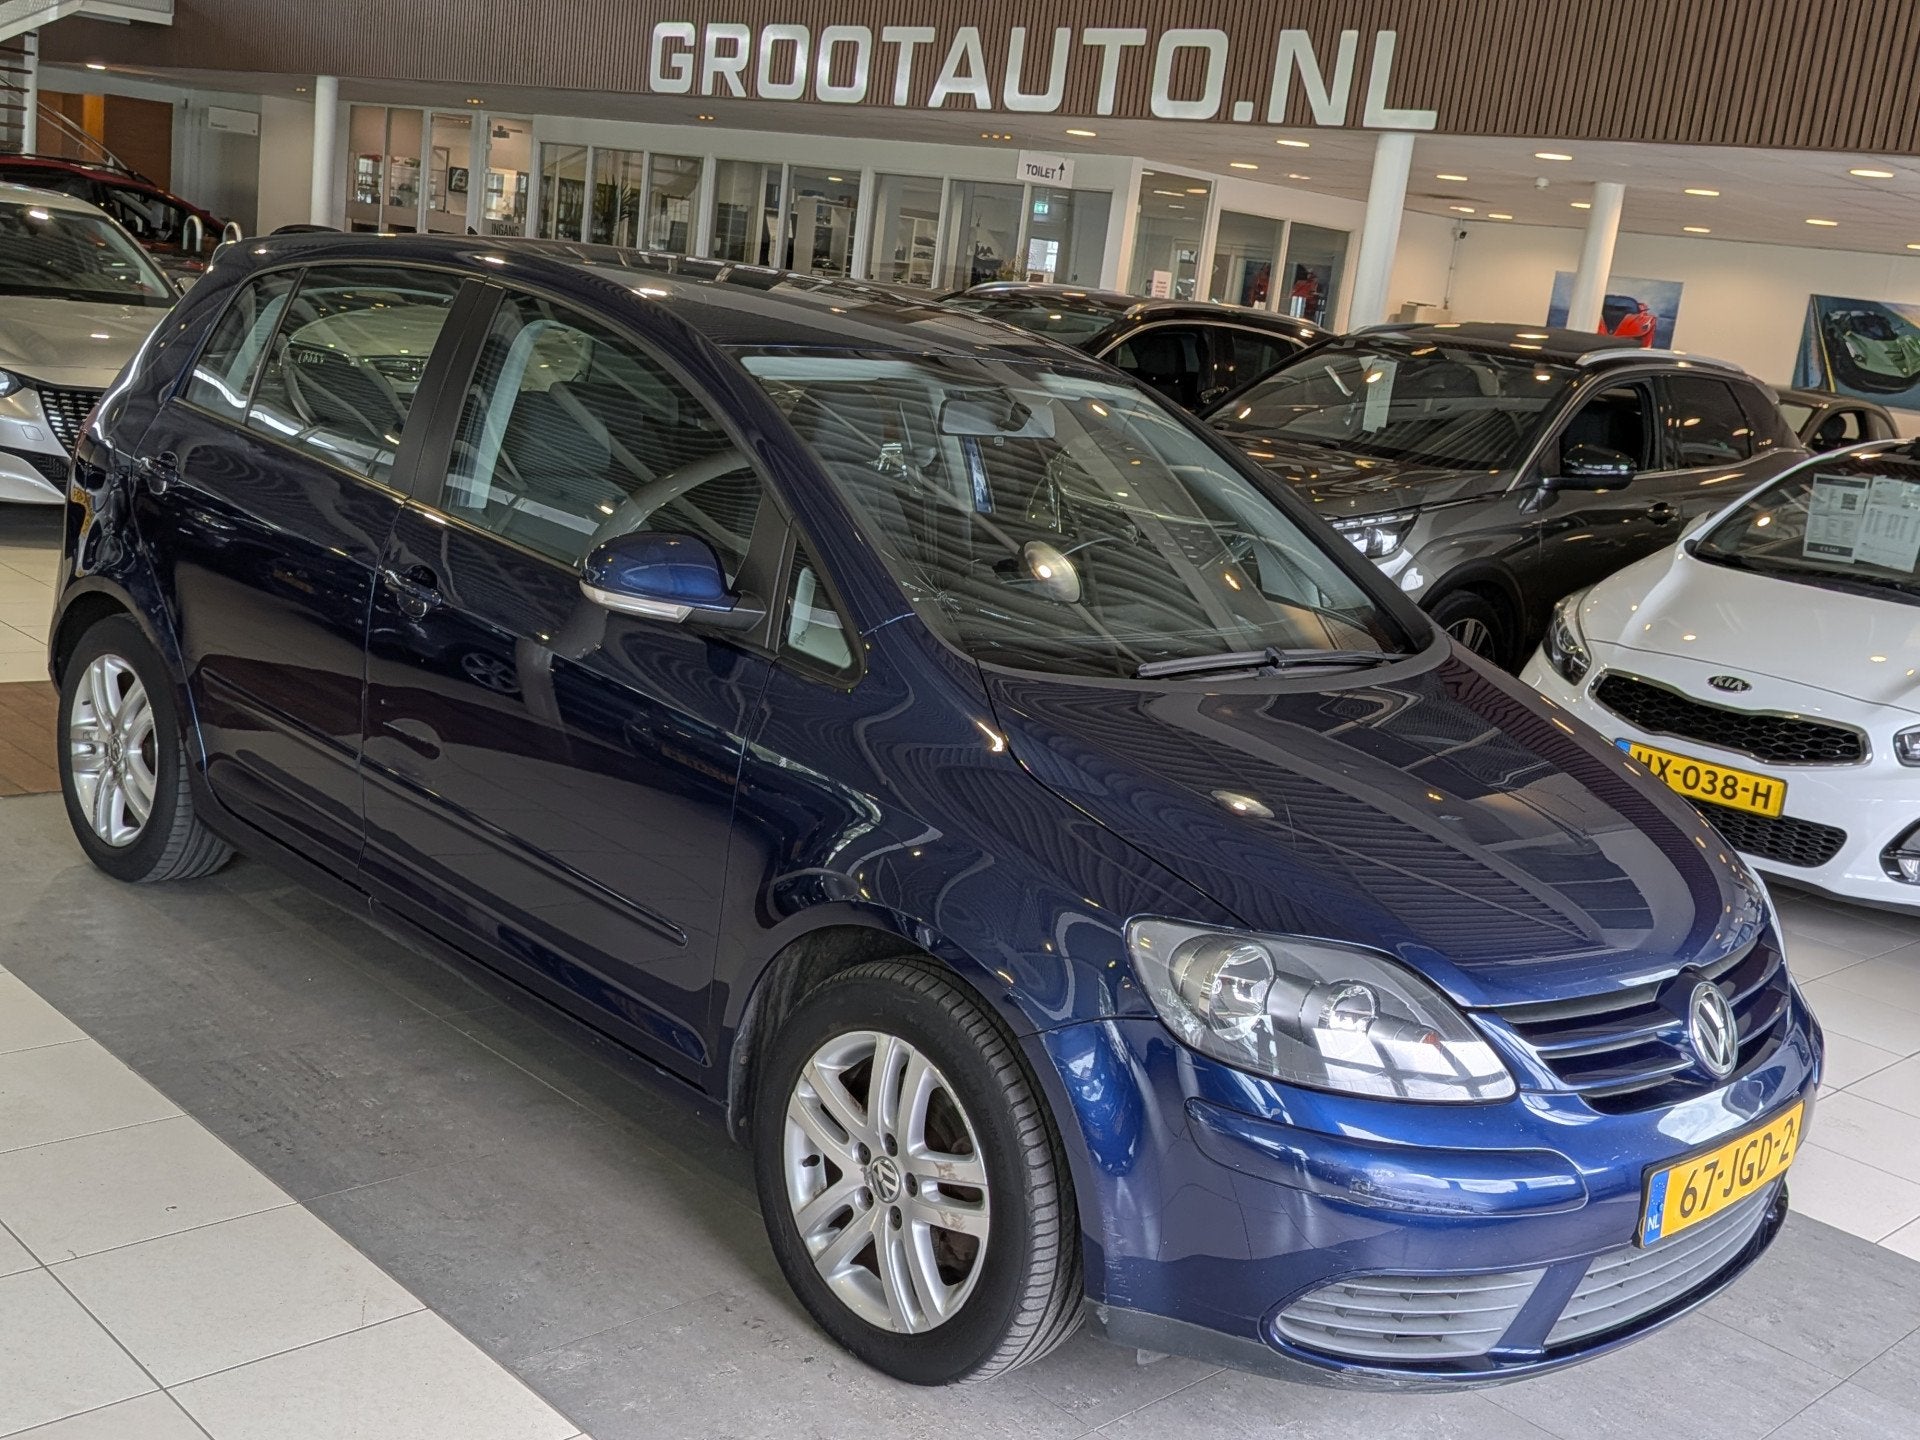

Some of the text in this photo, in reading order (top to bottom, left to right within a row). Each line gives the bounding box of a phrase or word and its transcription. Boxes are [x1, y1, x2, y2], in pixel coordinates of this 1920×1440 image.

[649, 22, 1438, 130] GROOTAUTO.NL
[1026, 163, 1056, 179] TOILET
[491, 222, 520, 236] INGANG
[1713, 677, 1743, 690] KIA
[1680, 1117, 1794, 1219] 67-JGD-2
[1647, 1214, 1660, 1230] NL
